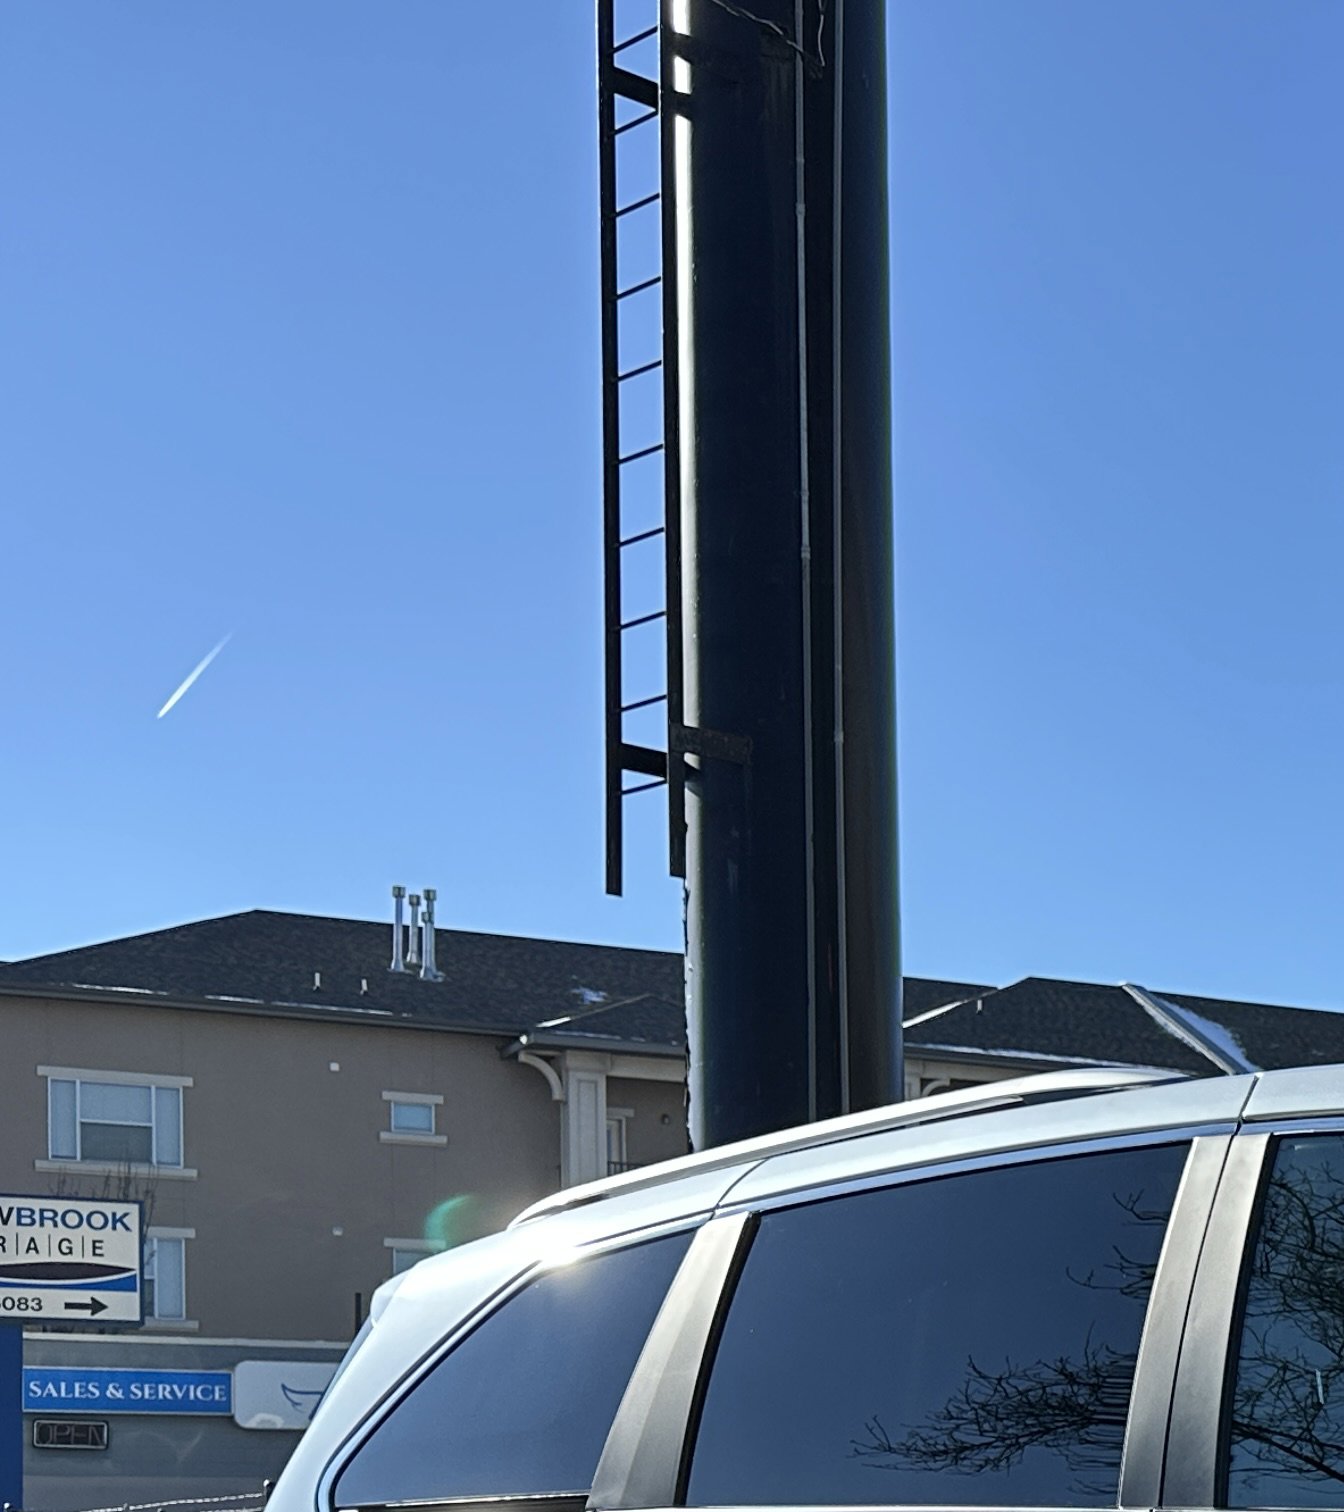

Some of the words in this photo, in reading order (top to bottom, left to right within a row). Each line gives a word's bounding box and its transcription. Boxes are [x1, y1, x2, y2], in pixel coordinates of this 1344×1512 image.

[0, 1295, 43, 1312] 083
[29, 1380, 100, 1399] SALES
[105, 1382, 125, 1400] &
[130, 1383, 226, 1401] SERVICE
[36, 1422, 106, 1446] OPEN
